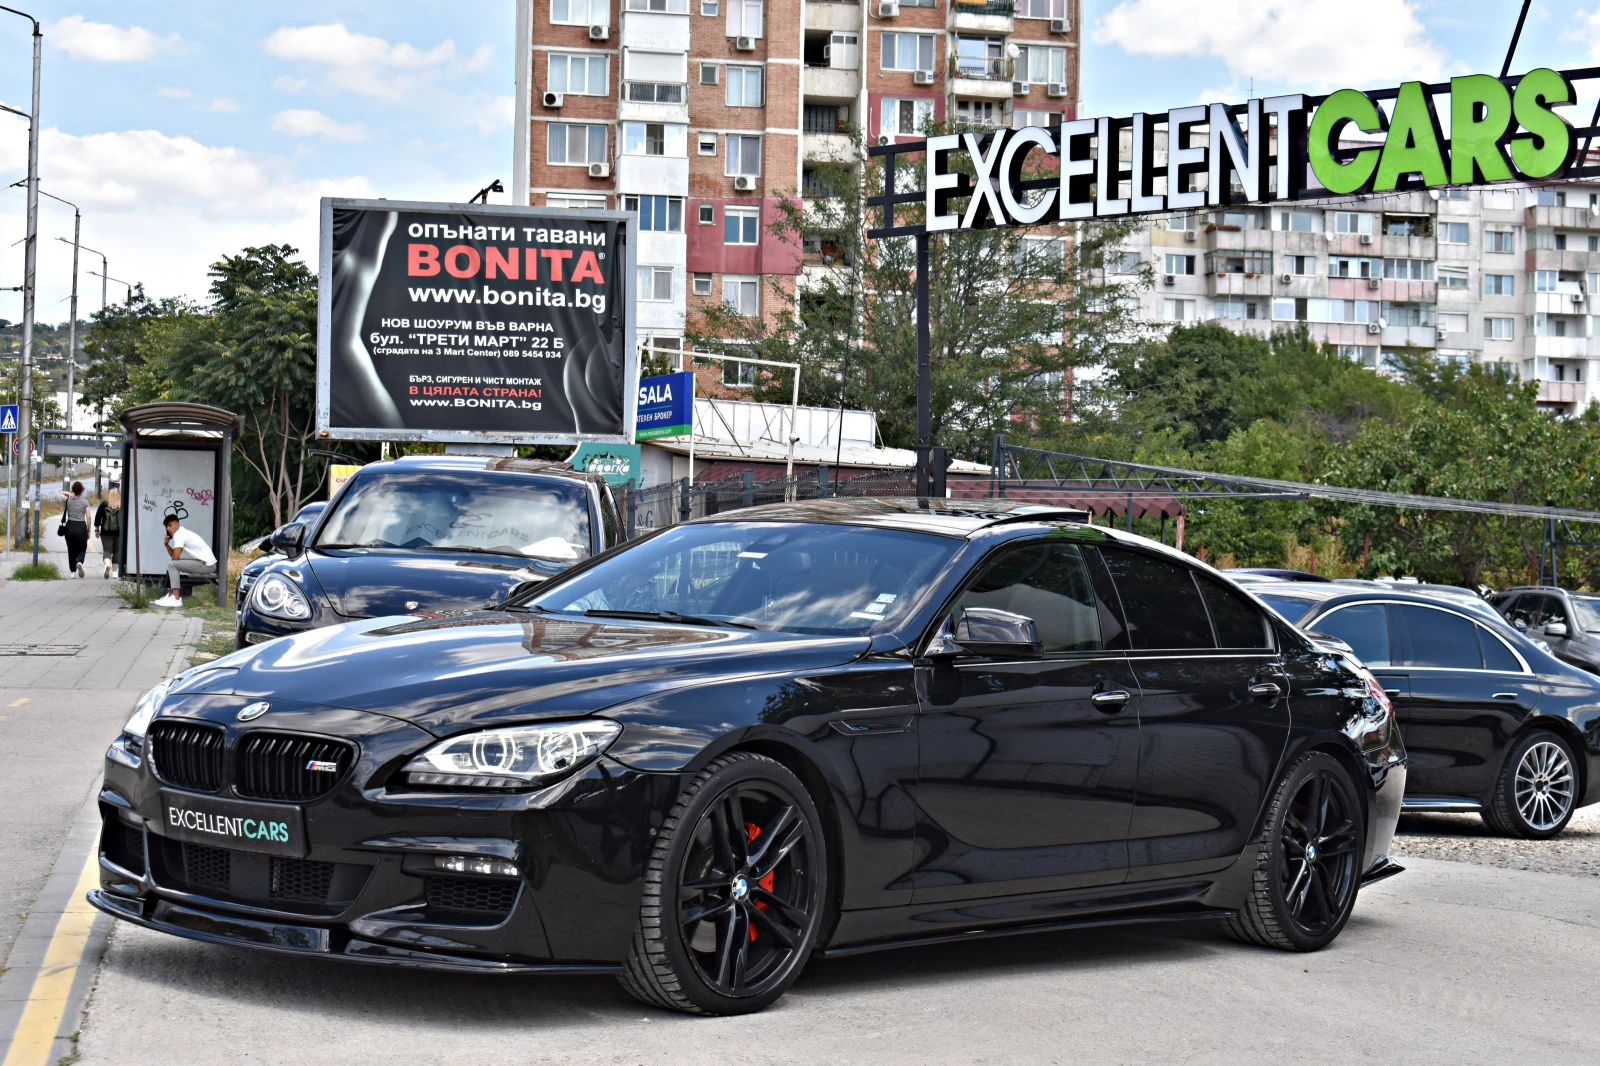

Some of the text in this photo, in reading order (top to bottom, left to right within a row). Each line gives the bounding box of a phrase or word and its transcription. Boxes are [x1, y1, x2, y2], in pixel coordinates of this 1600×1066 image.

[408, 223, 606, 247] опънати тавани
[408, 285, 606, 314] www.bonita.bg
[381, 318, 554, 332] НОВ ШОУРУМ ВЪВ ВАРНА
[370, 333, 404, 346] бул.
[531, 338, 549, 348] 22
[553, 338, 564, 349] Б
[373, 347, 419, 356] (сградата
[444, 348, 465, 356] Mart
[467, 348, 500, 358] Center)
[522, 350, 543, 358] 5454
[409, 375, 434, 384] БЪРЗ,
[436, 376, 473, 384] СИГУРЕН
[482, 377, 504, 385] ЧИСТ
[506, 378, 542, 386] МОНТАЖ
[409, 386, 542, 398] В ЦЯЛАТА СТРАНА!
[410, 398, 542, 411] www.BONITA.bg
